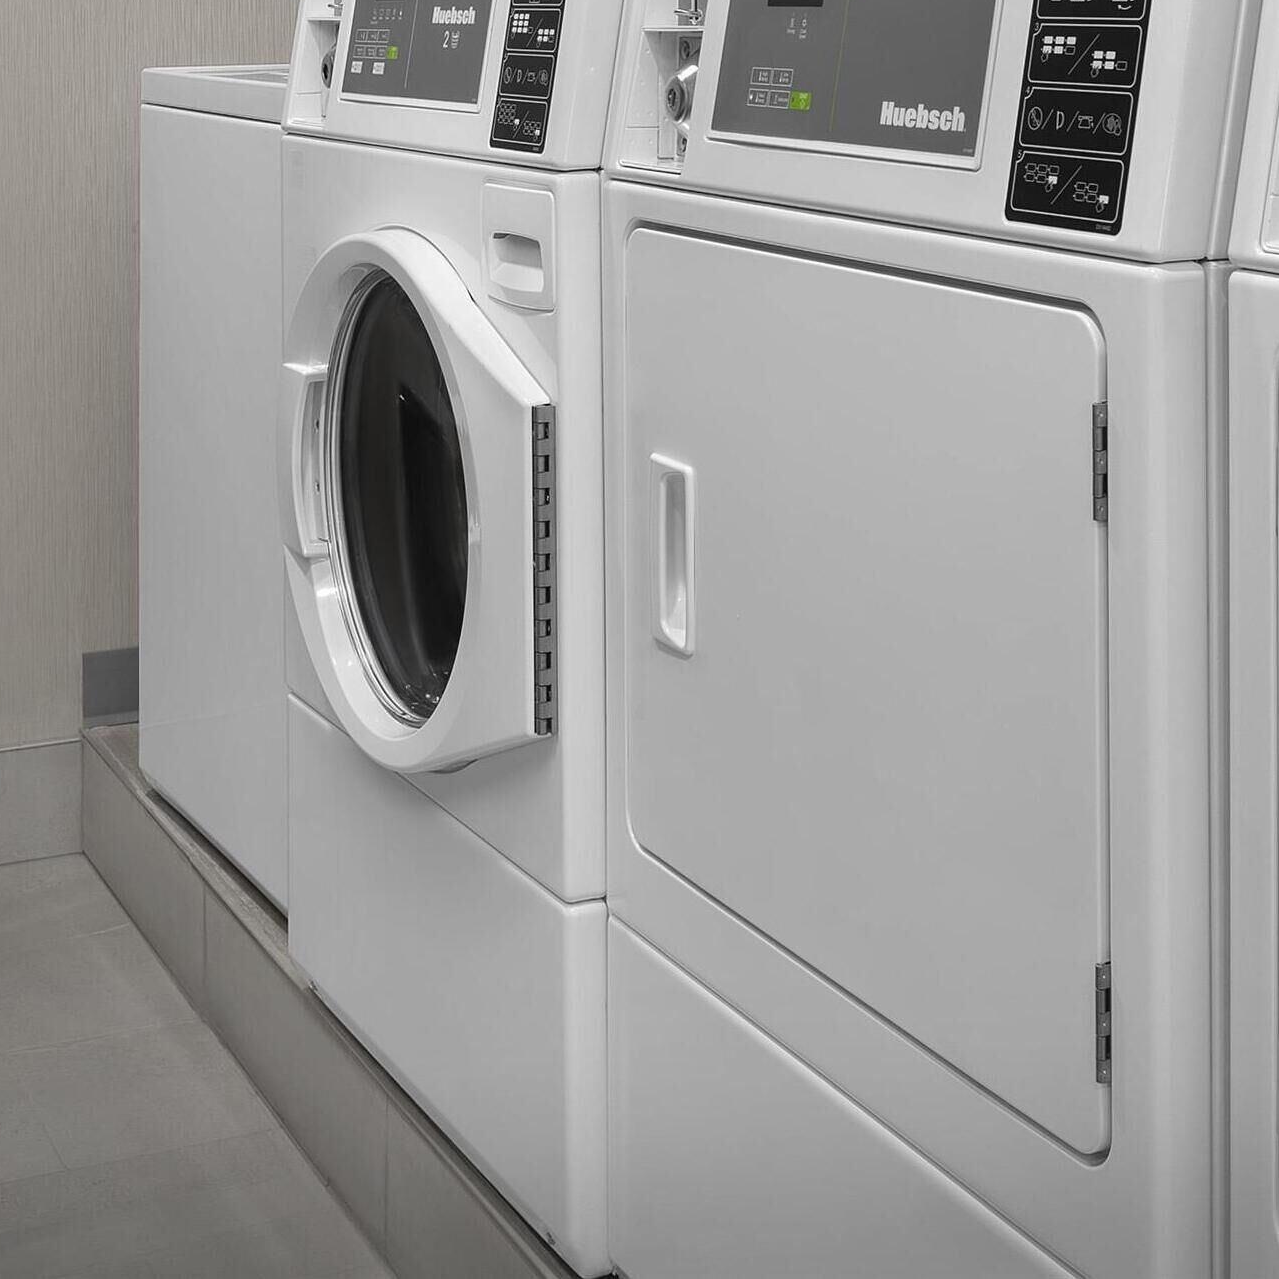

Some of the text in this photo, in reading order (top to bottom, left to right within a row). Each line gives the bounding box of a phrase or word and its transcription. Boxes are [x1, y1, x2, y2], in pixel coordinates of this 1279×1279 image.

[432, 6, 476, 24] Huebsch
[442, 30, 450, 48] 2
[880, 101, 966, 132] Huebsch
